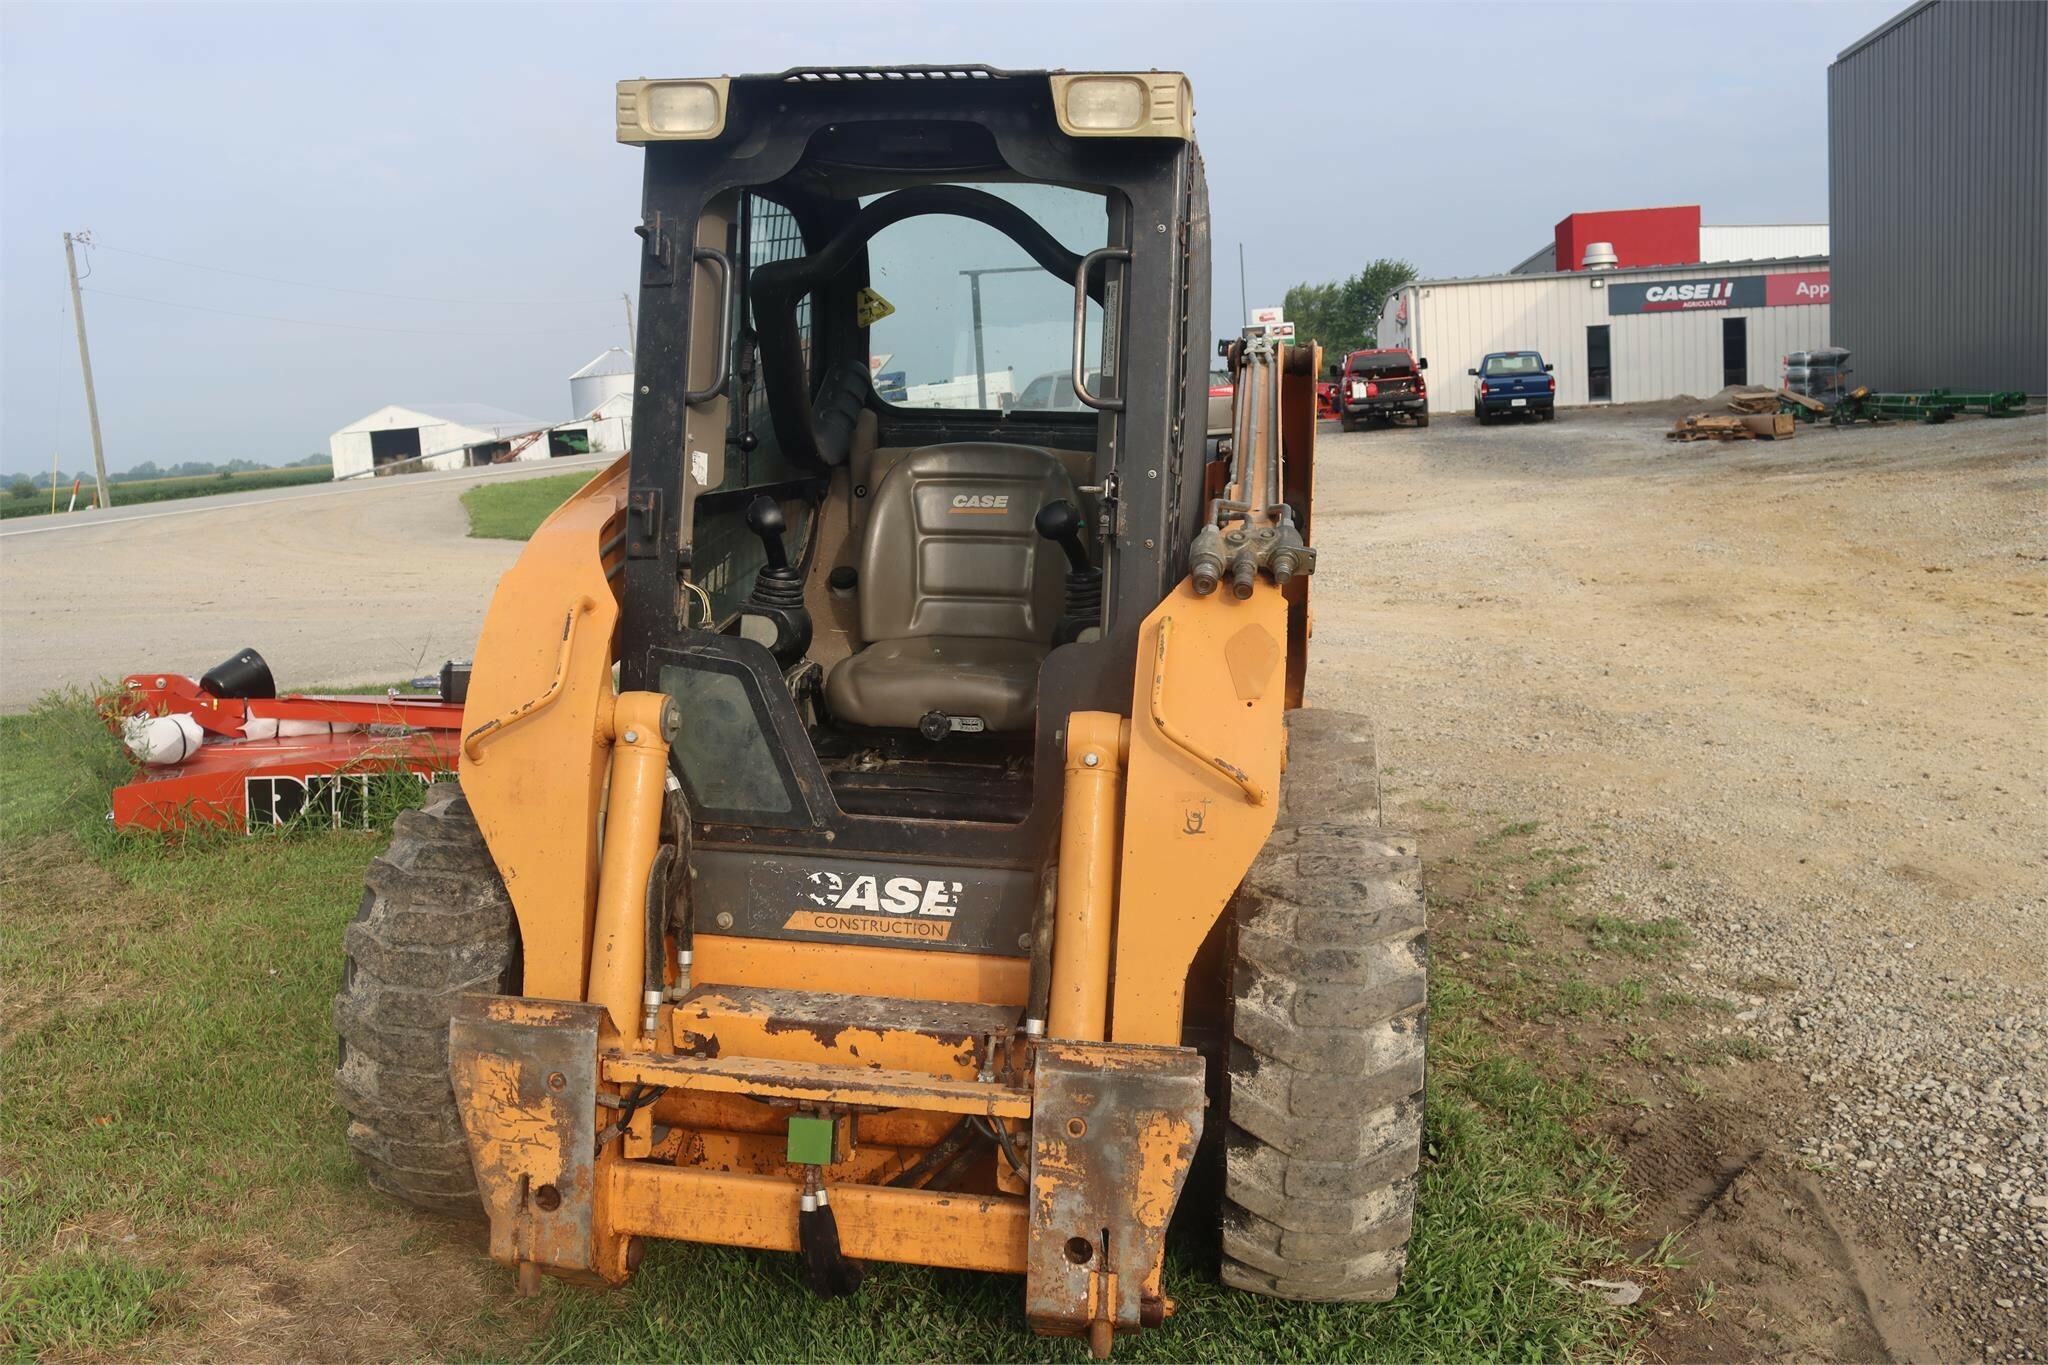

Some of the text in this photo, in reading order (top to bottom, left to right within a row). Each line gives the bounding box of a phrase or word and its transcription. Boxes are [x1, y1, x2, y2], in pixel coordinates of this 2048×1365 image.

[1645, 283, 1710, 302] CASE
[1682, 299, 1728, 308] AGRICULTURE
[952, 494, 1009, 508] CASE
[814, 915, 944, 937] CONSTRUCTION
